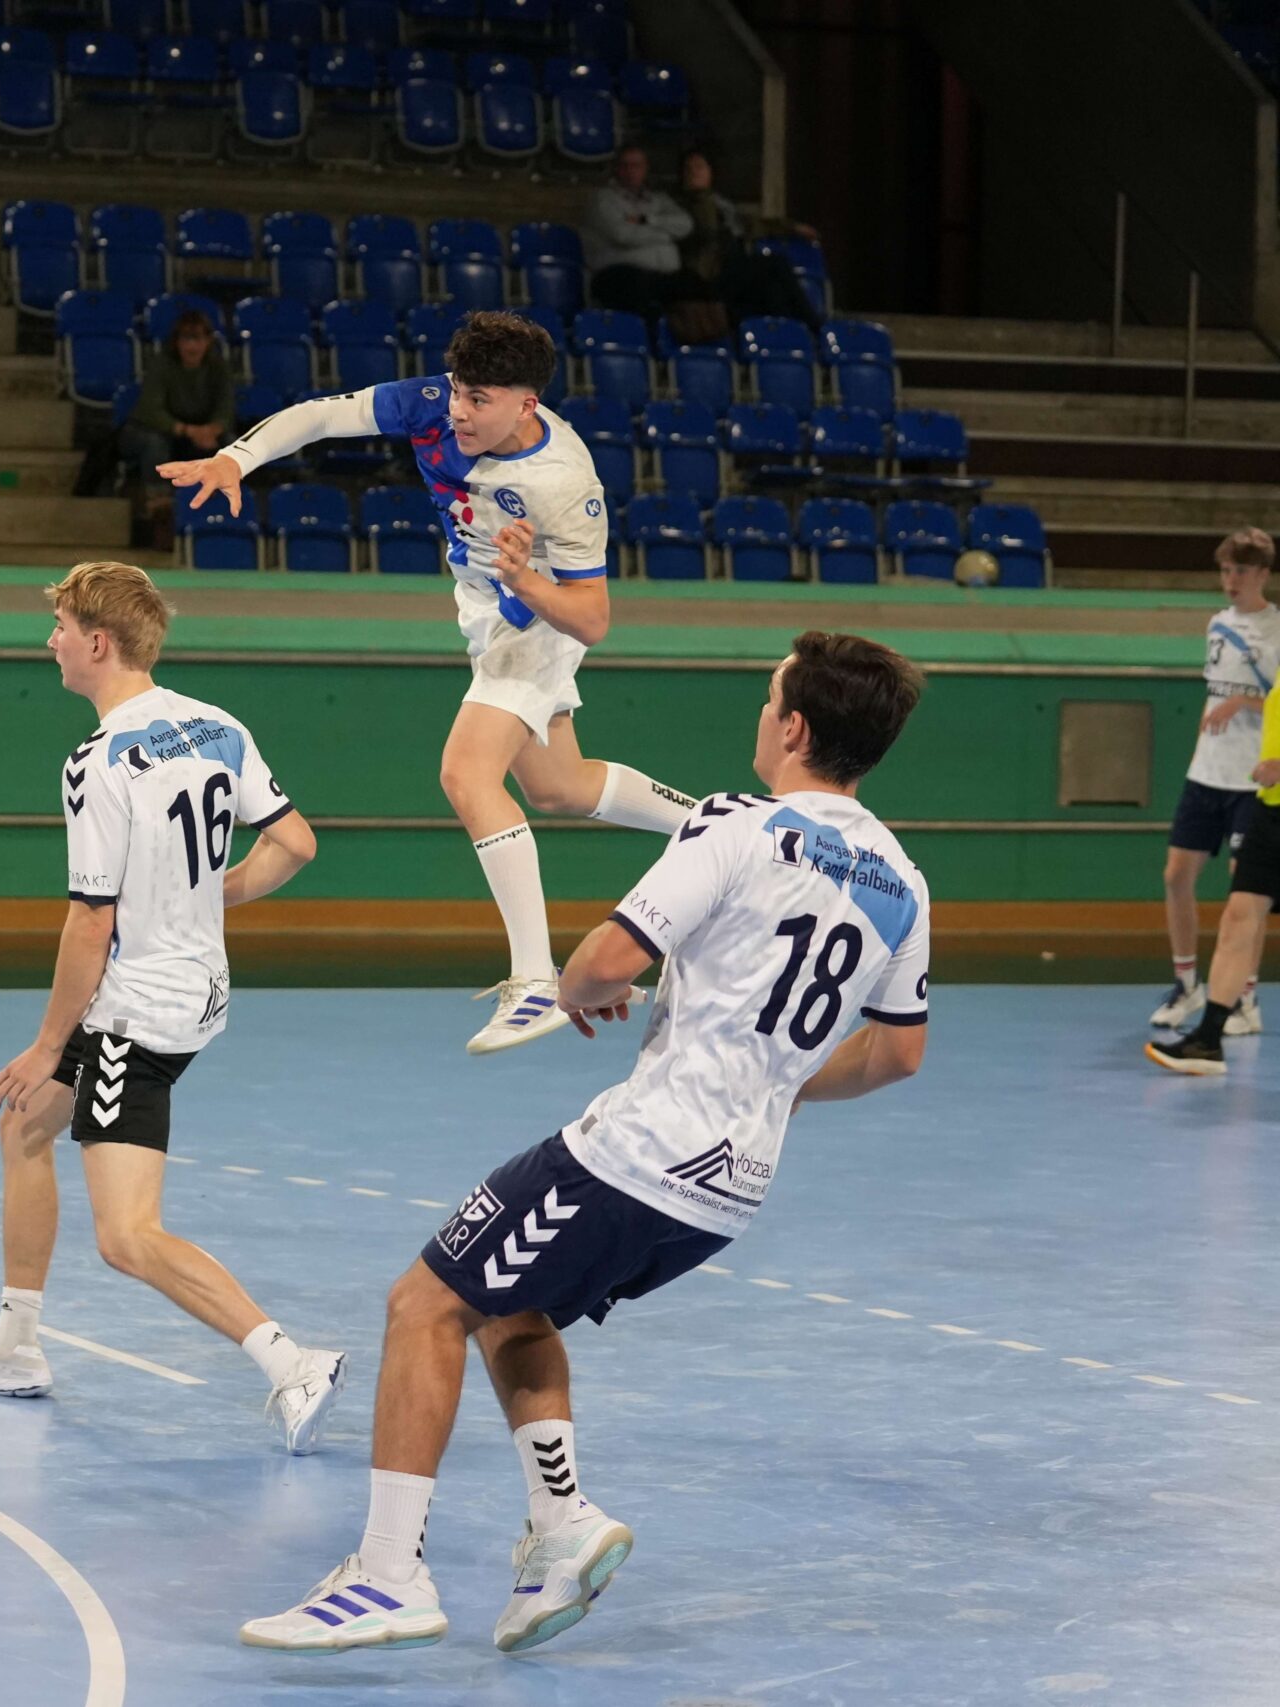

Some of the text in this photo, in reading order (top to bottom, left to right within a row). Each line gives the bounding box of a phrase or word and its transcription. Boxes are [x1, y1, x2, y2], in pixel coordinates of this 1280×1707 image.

[149, 716, 206, 746] Aargauische
[651, 781, 697, 809] empa
[167, 772, 232, 889] 16
[475, 826, 528, 849] Kempa
[810, 853, 907, 900] Kantonalbank
[755, 913, 863, 1051] 18
[661, 1176, 677, 1190] Ihr
[677, 1184, 721, 1210] Spezialist
